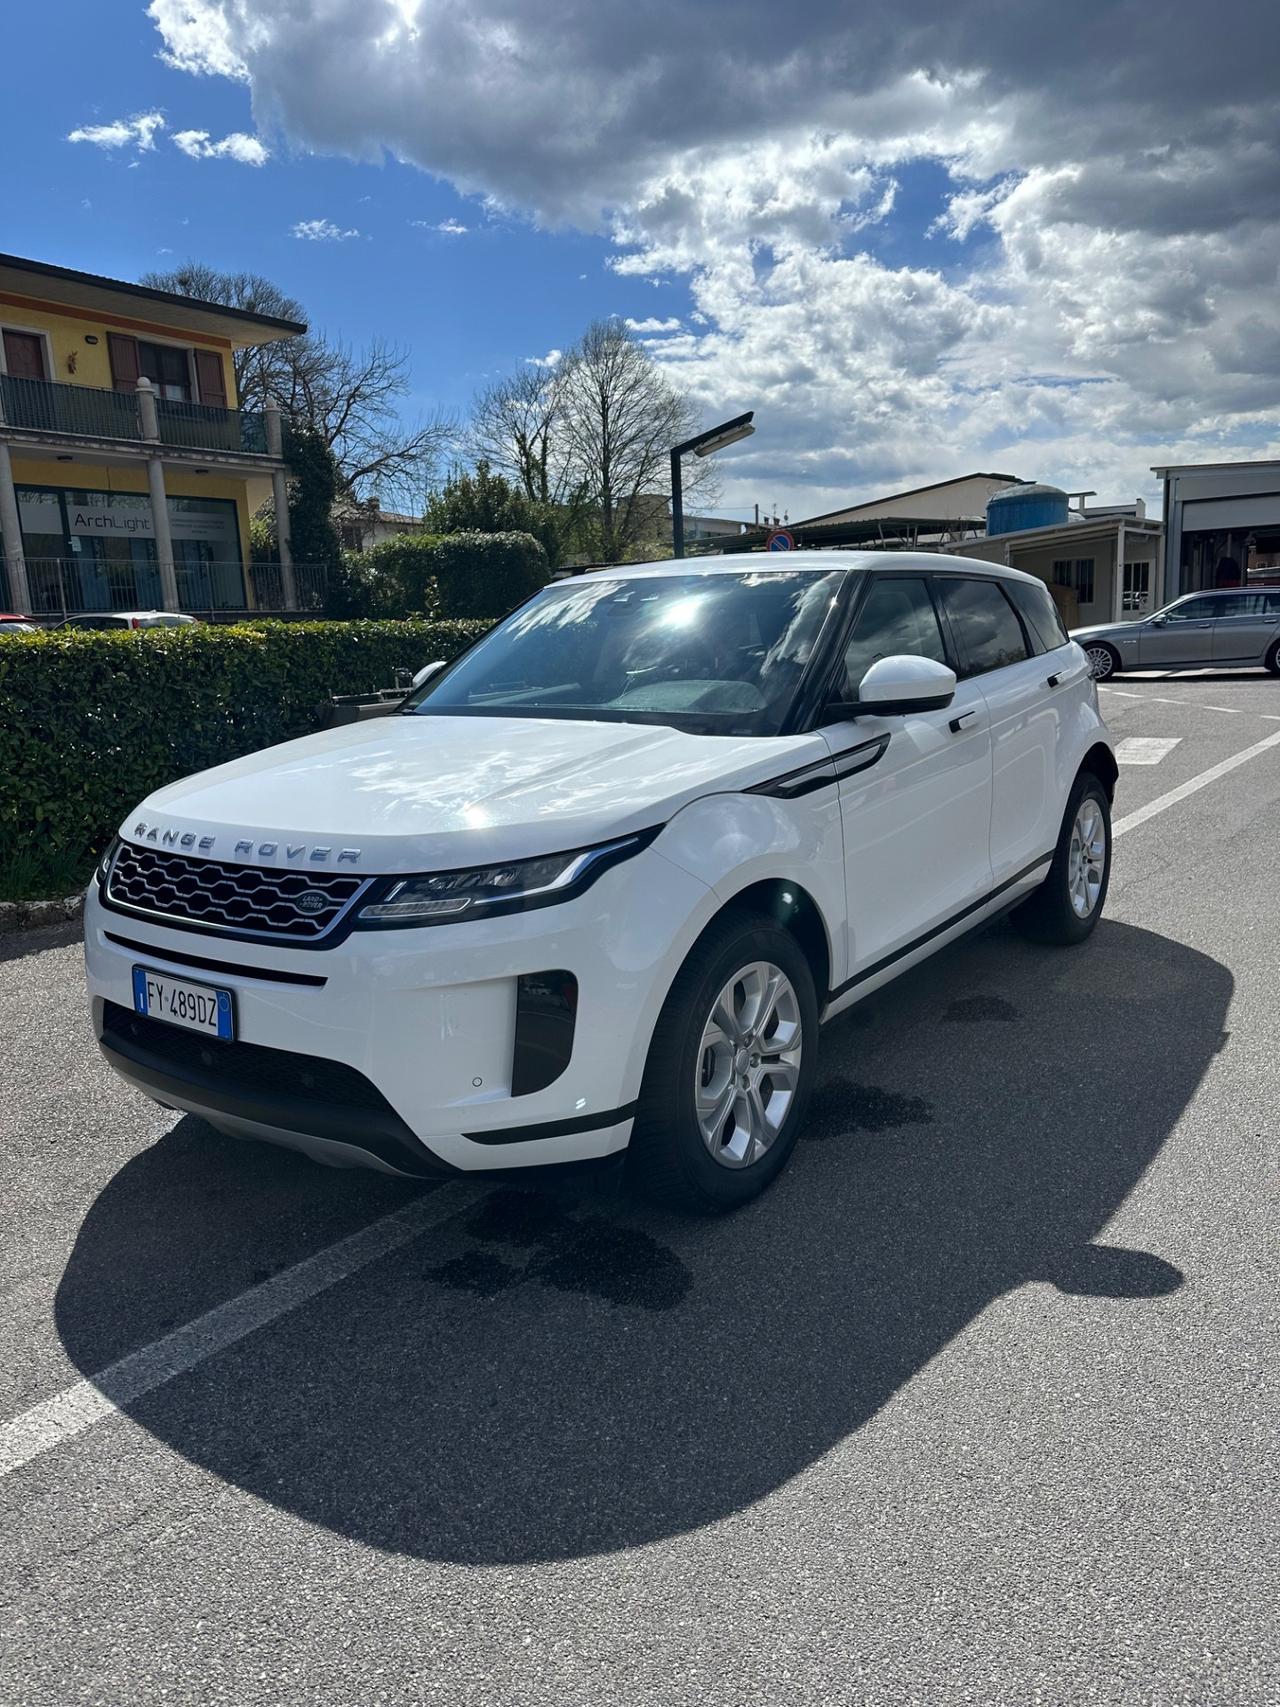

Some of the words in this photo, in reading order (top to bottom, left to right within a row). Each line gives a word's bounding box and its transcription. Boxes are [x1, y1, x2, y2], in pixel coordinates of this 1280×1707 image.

[74, 513, 151, 532] ArchLight
[134, 822, 216, 849] RANGE
[234, 838, 361, 864] ROVER
